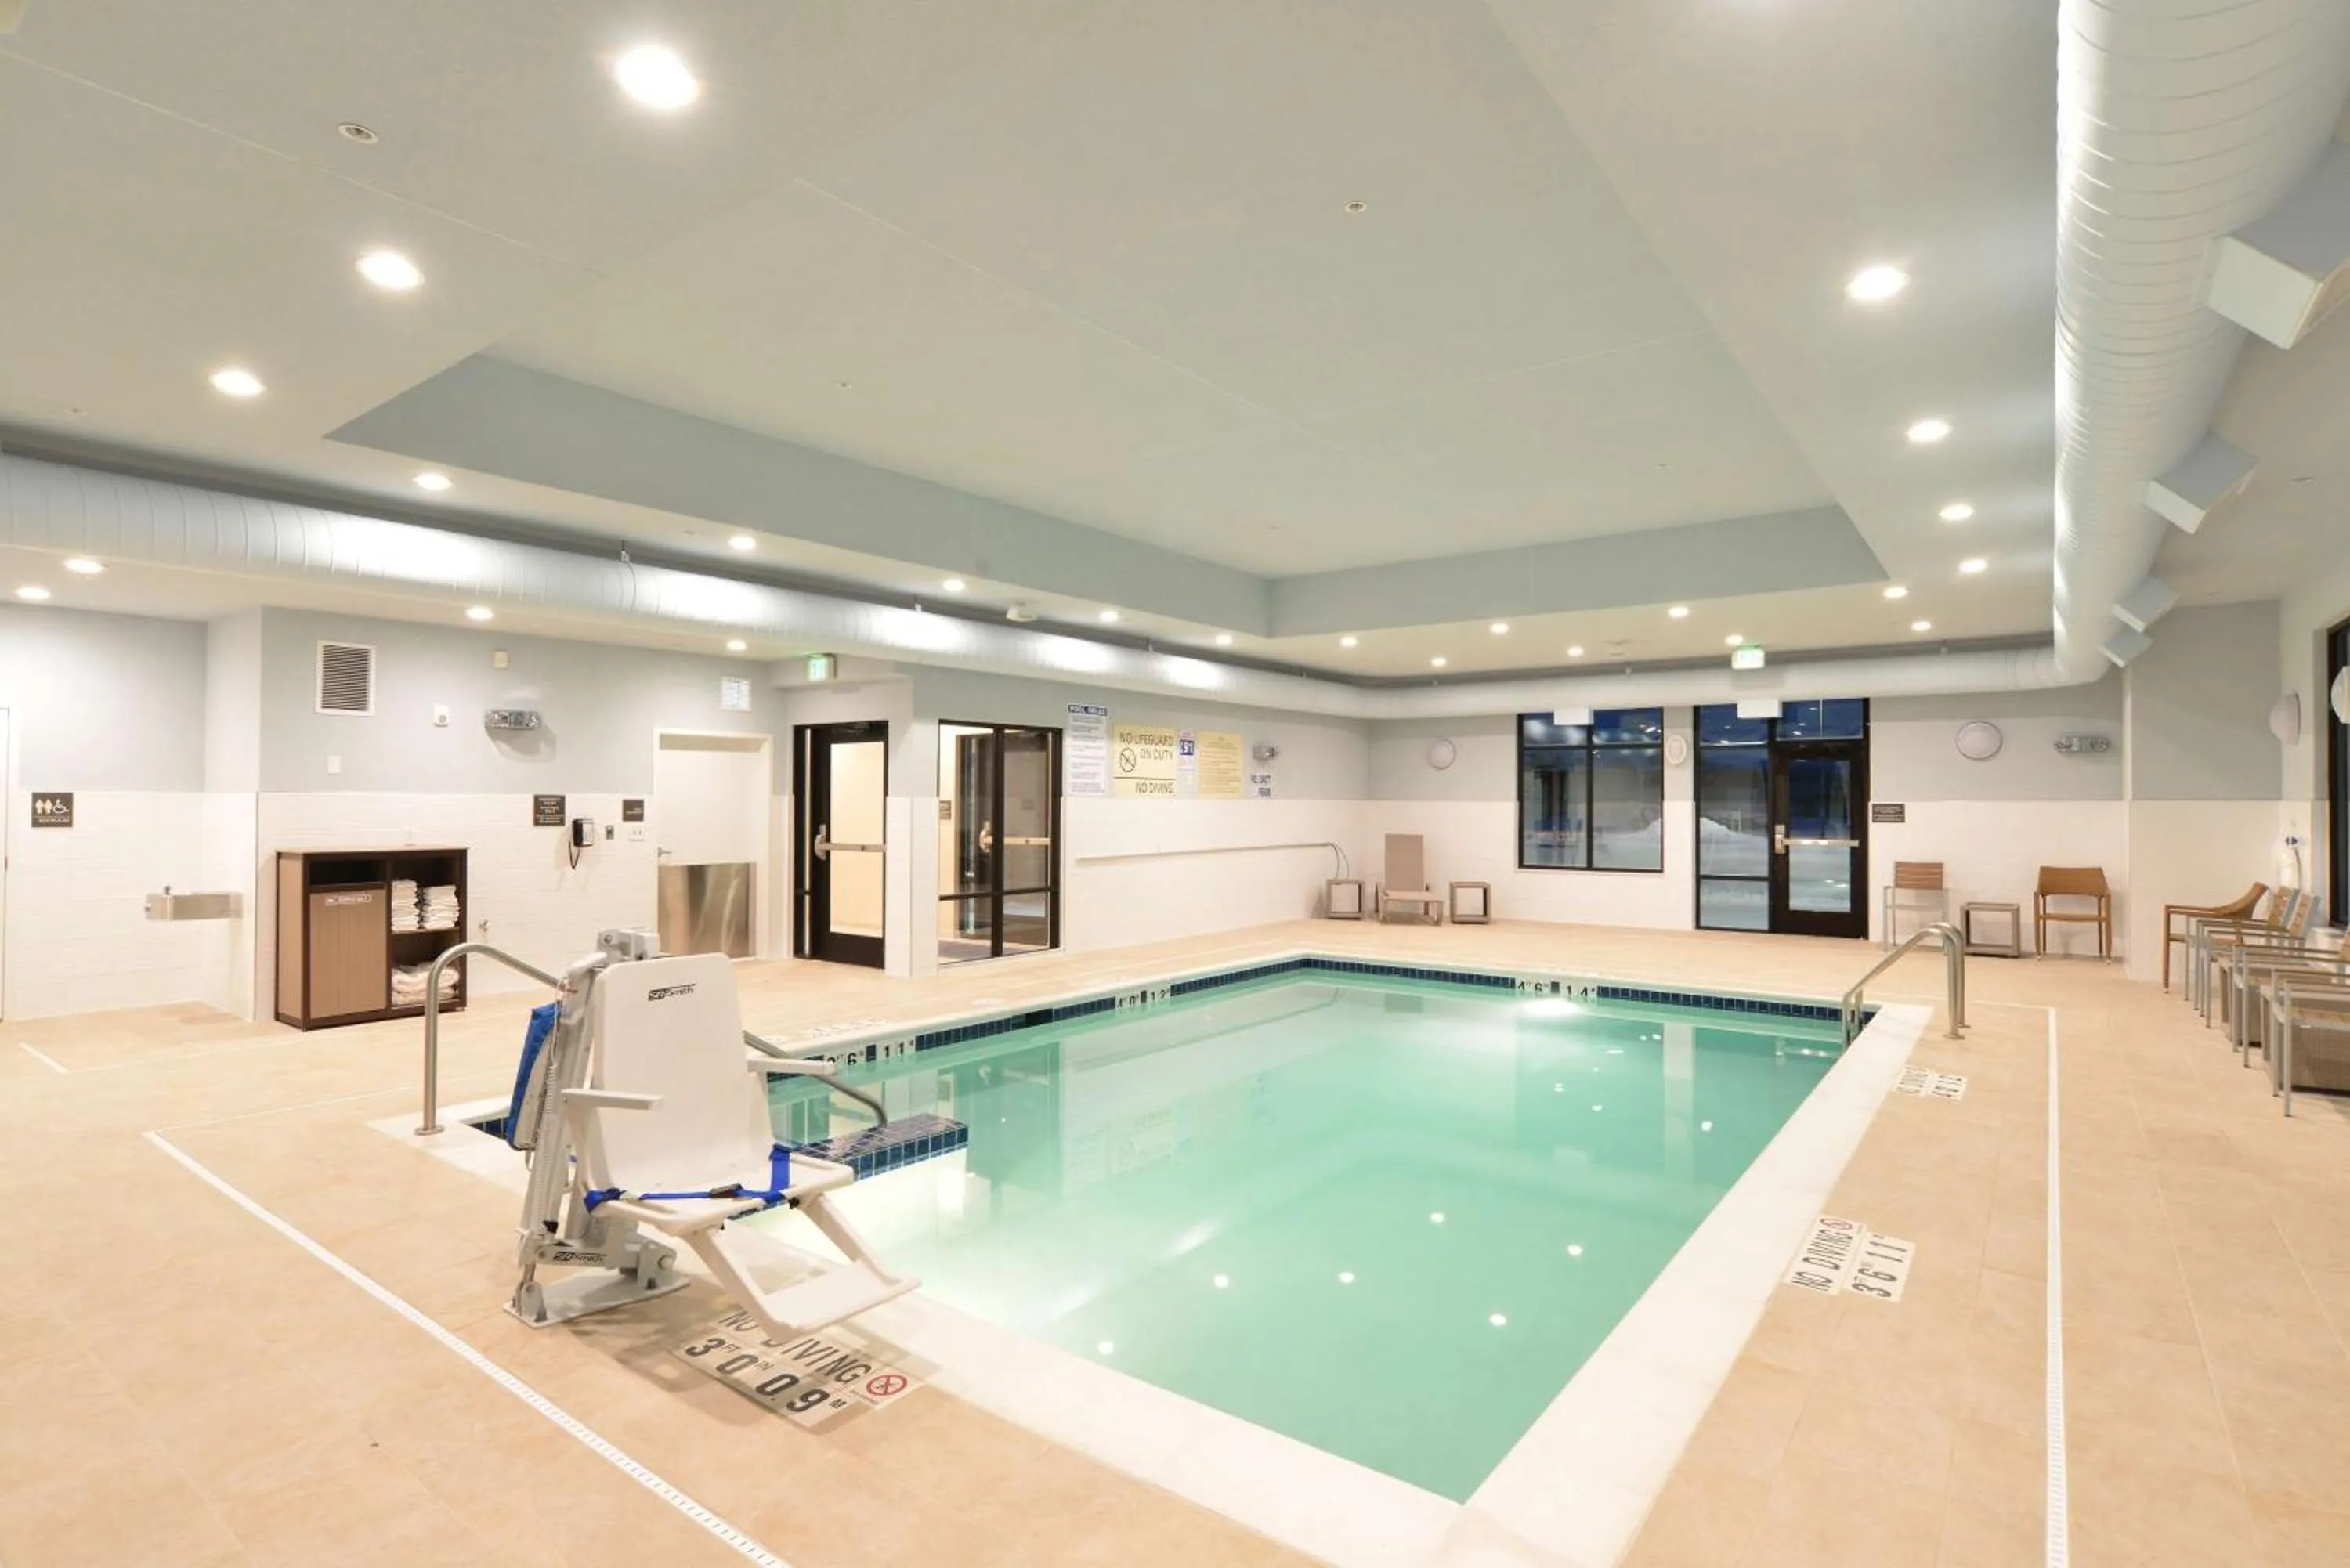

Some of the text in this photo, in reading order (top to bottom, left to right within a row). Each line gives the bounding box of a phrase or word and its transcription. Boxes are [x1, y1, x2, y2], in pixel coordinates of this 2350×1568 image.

[1119, 732, 1132, 744] NO
[1154, 750, 1173, 761] DUTY
[1135, 782, 1148, 793] NO
[1791, 1229, 1854, 1292] NO DIVING
[1857, 1267, 1898, 1283] 6
[1851, 1281, 1893, 1299] 3
[718, 1310, 759, 1331] NO
[685, 1337, 725, 1357] 3
[716, 1353, 759, 1375] 0
